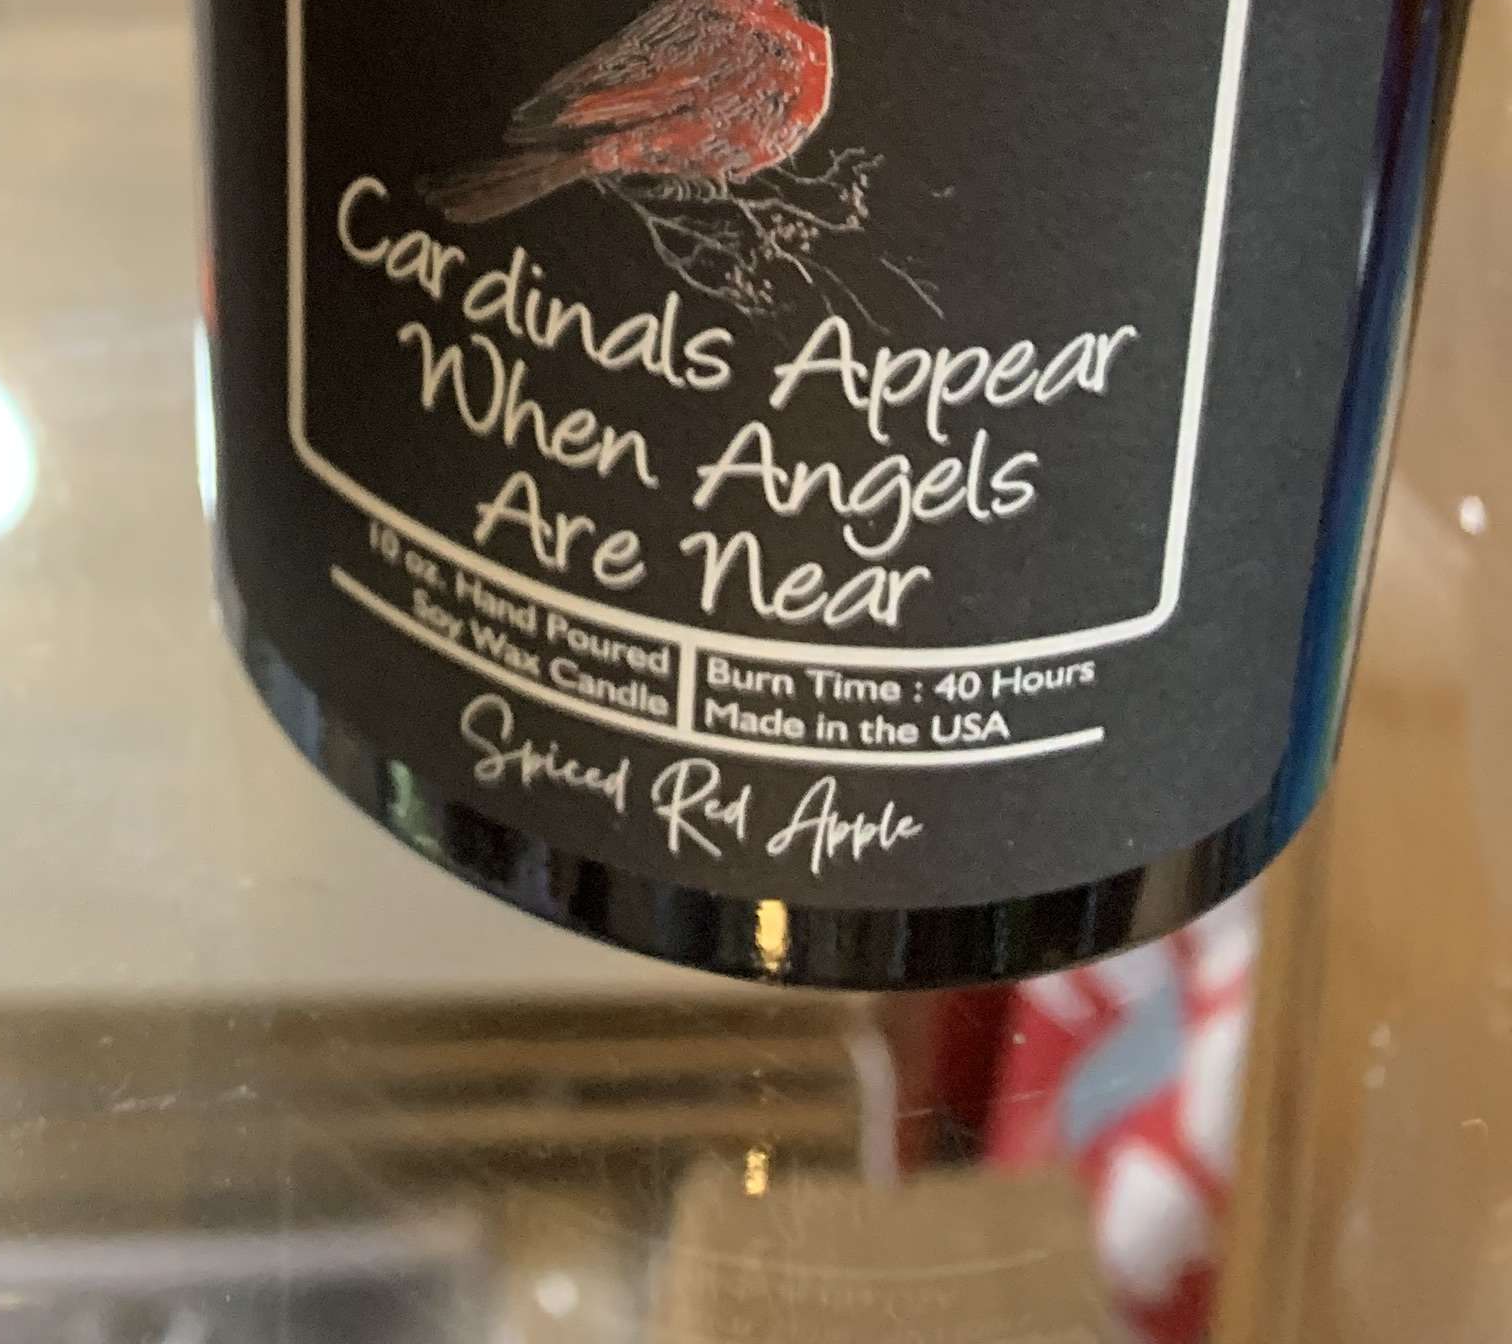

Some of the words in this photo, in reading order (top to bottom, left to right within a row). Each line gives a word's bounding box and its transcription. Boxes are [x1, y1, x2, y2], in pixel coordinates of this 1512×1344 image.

[337, 175, 734, 389] Cardinals
[769, 315, 1136, 443] Appear
[399, 323, 660, 488] When
[694, 421, 1037, 553] Angels
[473, 473, 645, 588] Are
[681, 530, 928, 627] Near
[455, 574, 535, 634] Hand
[545, 611, 671, 675] Poured
[473, 621, 541, 677] Wax
[551, 658, 669, 717] Candle
[707, 658, 795, 696] Burn
[807, 668, 901, 703] Time
[937, 673, 980, 704] 40
[991, 658, 1095, 697] Hours
[461, 693, 627, 812] Spiced
[652, 757, 745, 855] Red
[767, 775, 922, 874] Apple
[705, 700, 804, 739] Made
[816, 714, 848, 742] in
[859, 715, 919, 745] the
[929, 711, 1010, 745] USA
